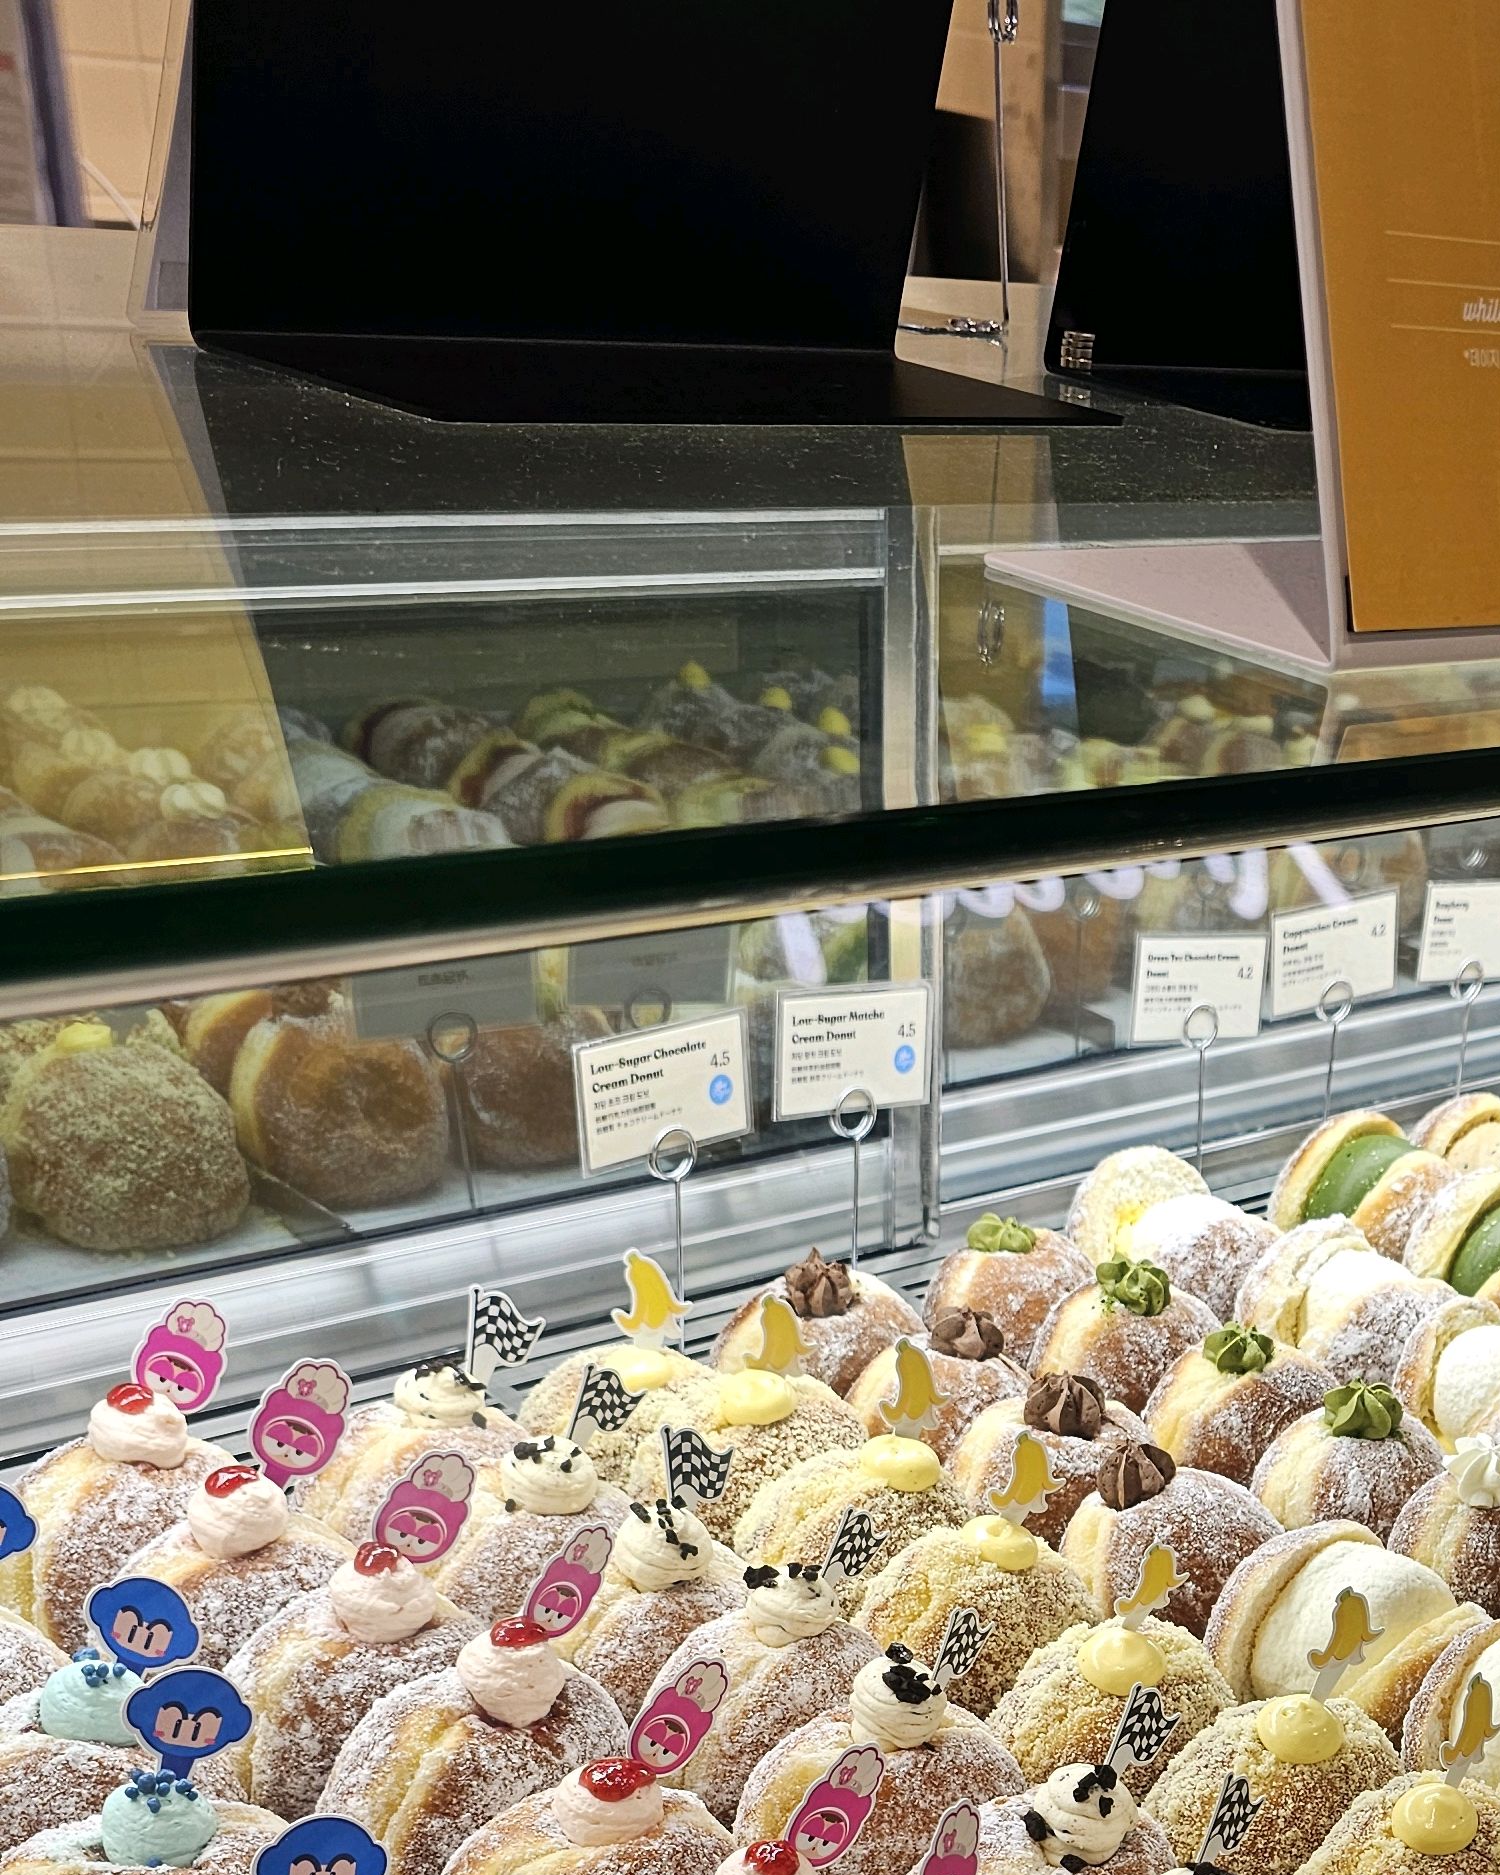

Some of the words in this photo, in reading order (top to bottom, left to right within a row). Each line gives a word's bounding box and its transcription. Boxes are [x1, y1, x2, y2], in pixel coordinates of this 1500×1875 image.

[1238, 967, 1254, 979] 4.2
[792, 1013, 848, 1027] Low-Sugar
[849, 1009, 885, 1021] Matcha
[792, 1033, 824, 1044] Cream
[827, 1030, 856, 1042] Donut
[898, 1023, 916, 1038] 4.5
[590, 1054, 652, 1076] Low-Sugar
[653, 1040, 706, 1061] Chocolate
[710, 1051, 730, 1068] 4.5
[592, 1079, 628, 1094] Cream
[630, 1068, 664, 1084] Donut
